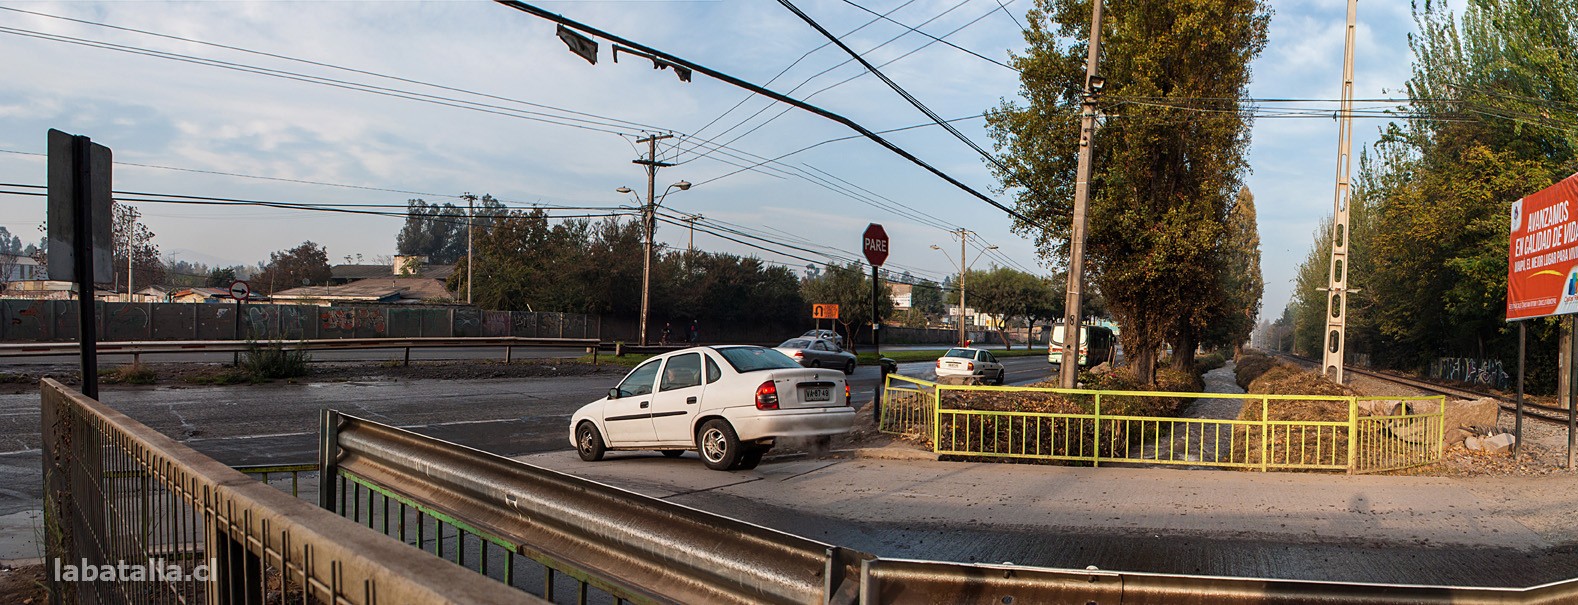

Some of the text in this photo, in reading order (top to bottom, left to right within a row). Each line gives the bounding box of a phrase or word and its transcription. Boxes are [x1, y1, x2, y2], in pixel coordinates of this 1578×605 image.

[1527, 200, 1569, 233] AVANZAMOS
[864, 237, 887, 252] PARE
[1515, 237, 1524, 257] EN
[1524, 229, 1552, 255] CALIDAD
[1552, 225, 1563, 248] DE
[1526, 258, 1531, 270] EL
[1531, 254, 1544, 269] MEJOR
[1544, 251, 1557, 266] LUGAR
[1557, 248, 1568, 263] PARA
[1070, 315, 1075, 325] 8
